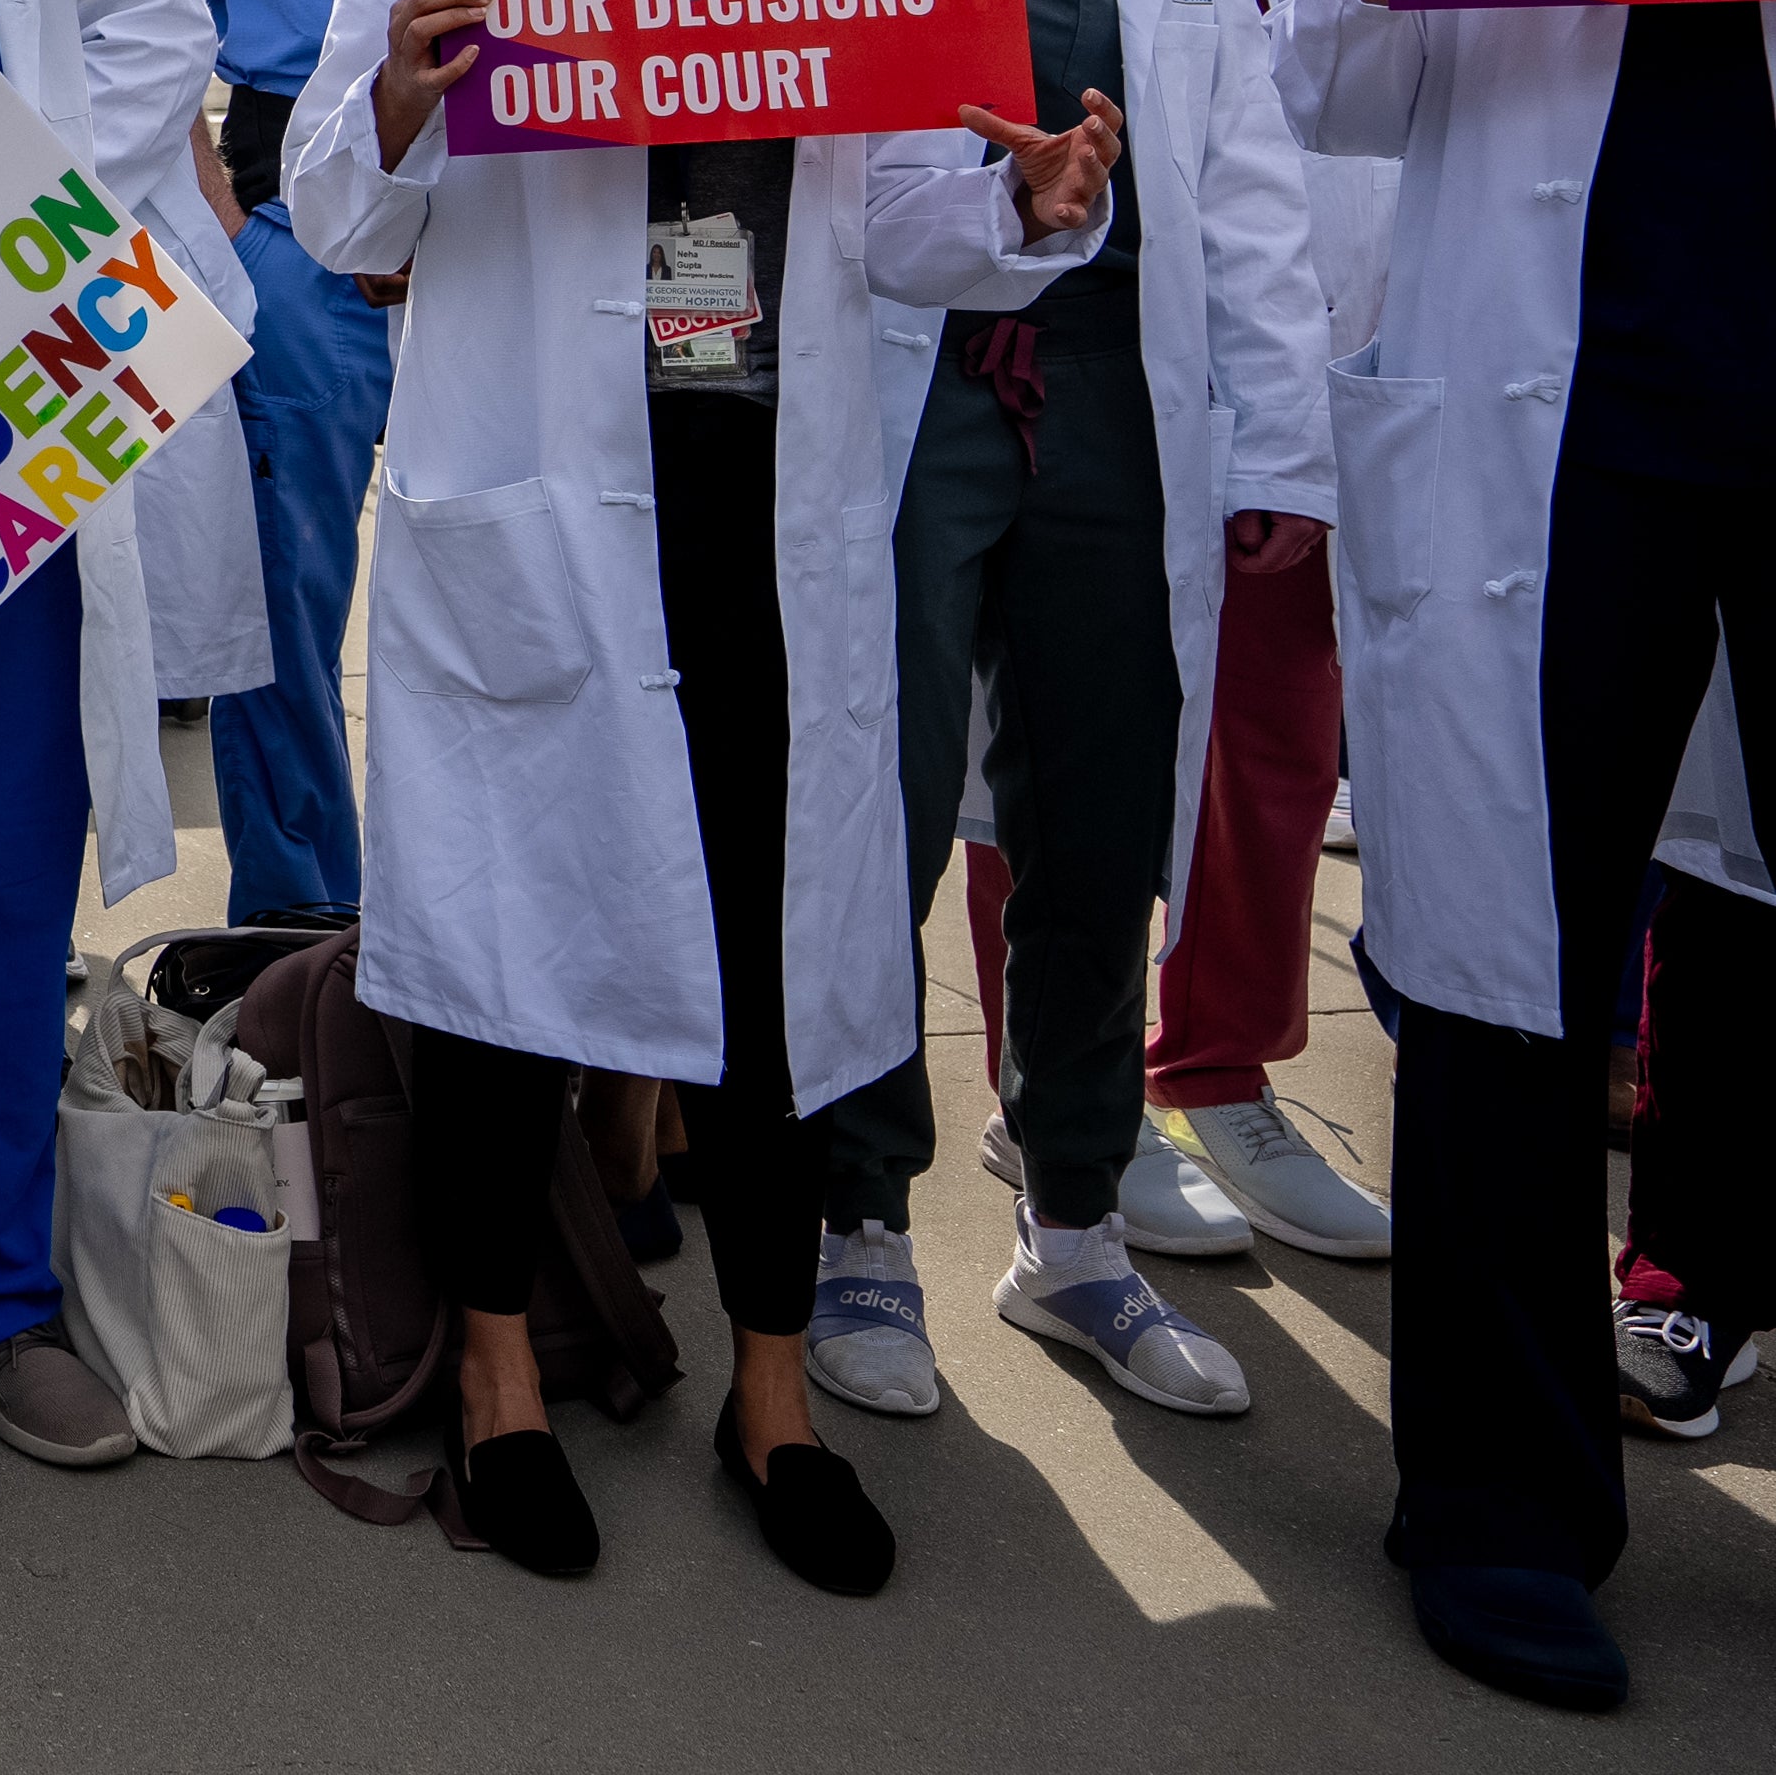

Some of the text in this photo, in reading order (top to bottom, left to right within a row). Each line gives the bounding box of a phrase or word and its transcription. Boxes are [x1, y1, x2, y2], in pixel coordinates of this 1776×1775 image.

[490, 47, 831, 126] OUR COURT
[677, 250, 698, 258] Neha
[677, 261, 701, 270] Gupta
[655, 287, 741, 296] GEORGE WASHINGTON
[685, 297, 741, 307] HOSPITAL
